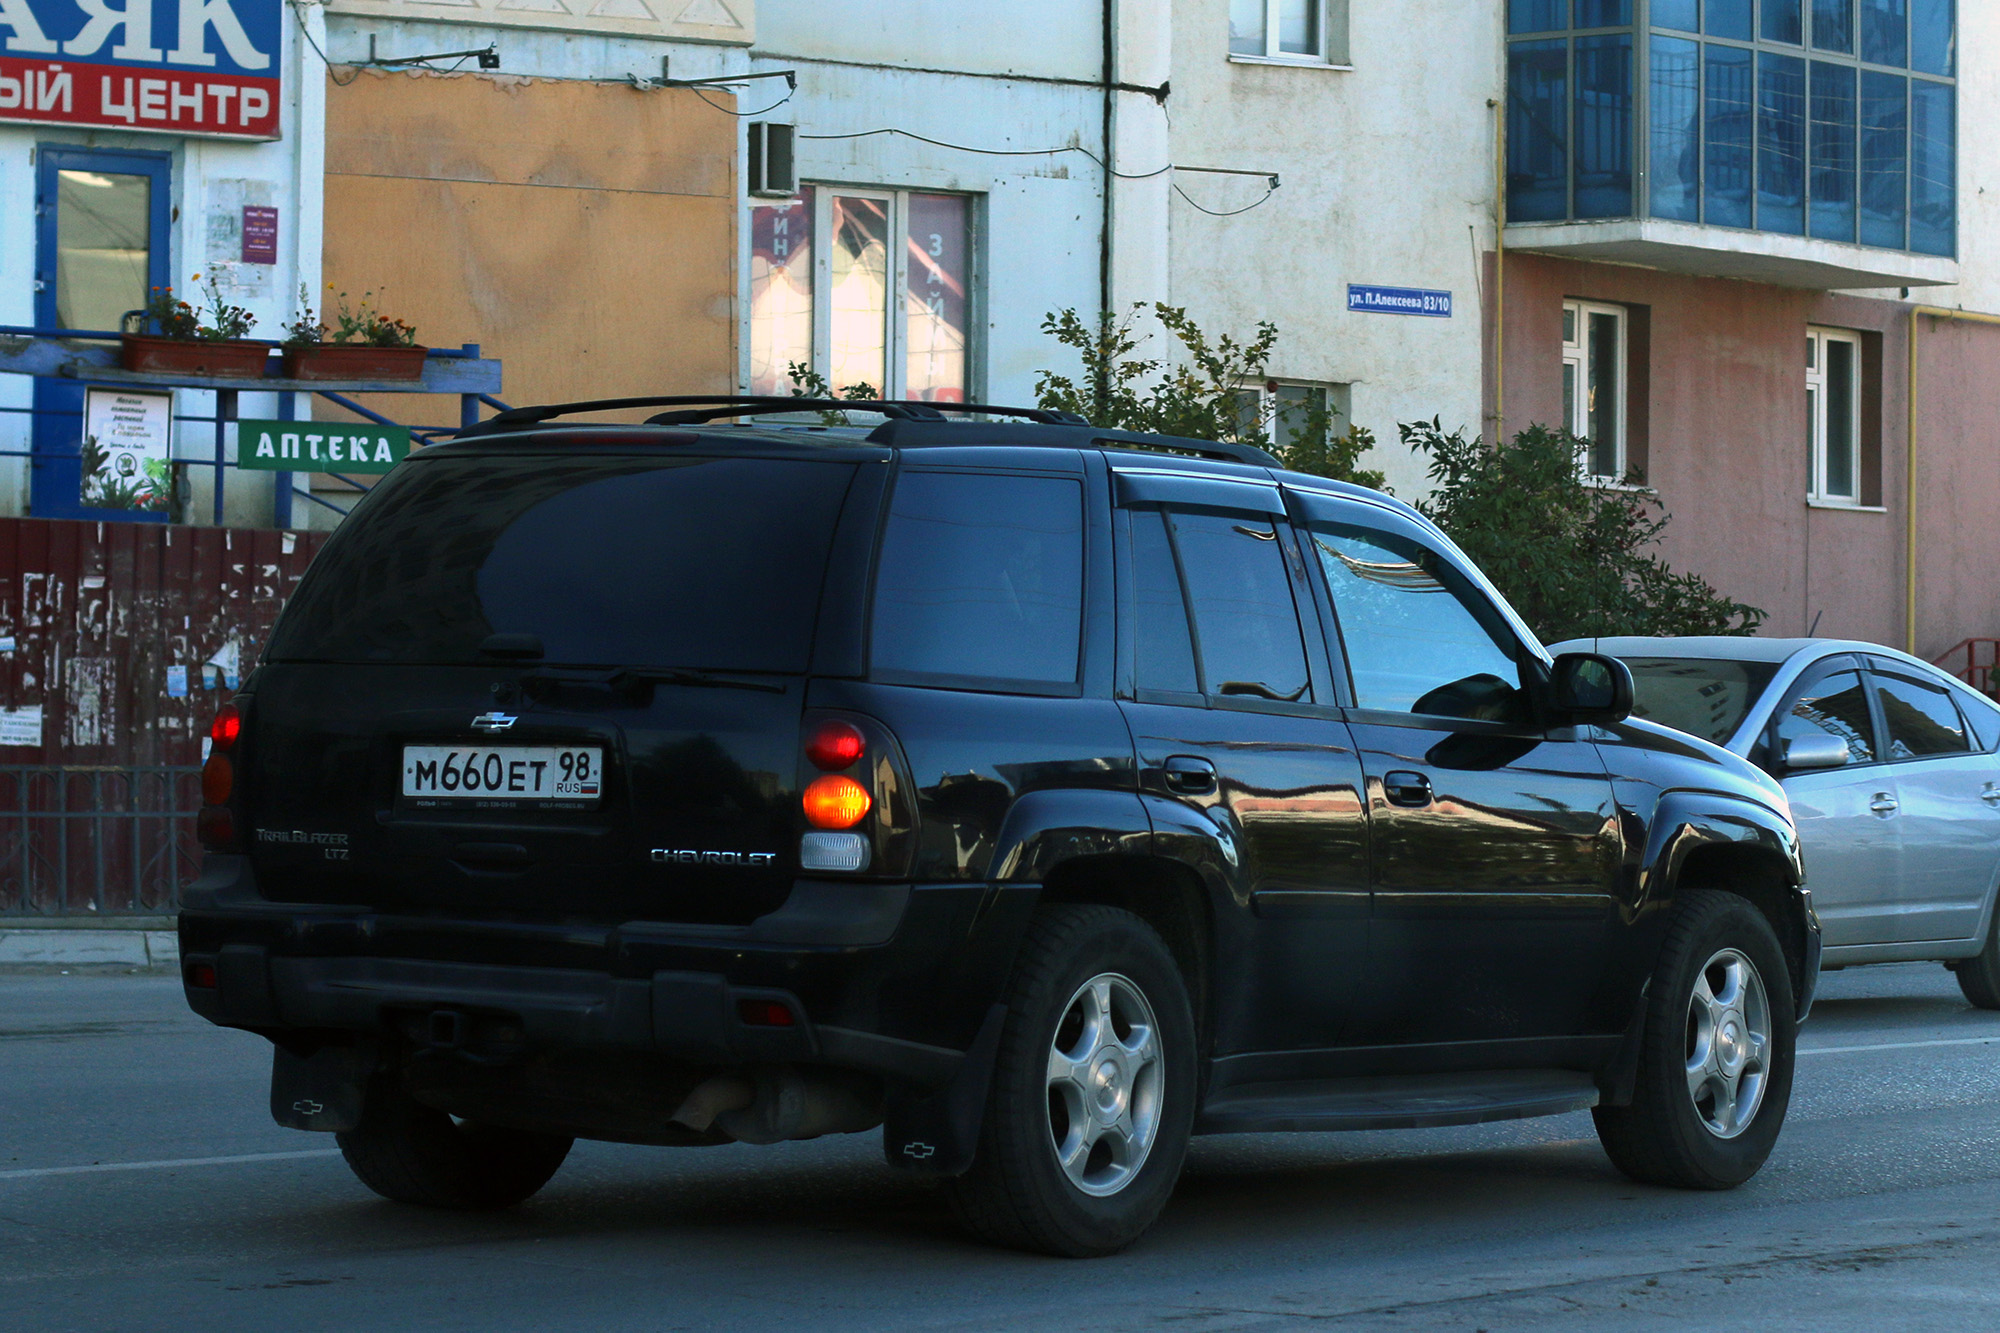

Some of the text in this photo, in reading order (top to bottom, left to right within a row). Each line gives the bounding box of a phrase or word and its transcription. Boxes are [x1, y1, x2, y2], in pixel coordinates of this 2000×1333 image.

[101, 75, 270, 126] ЦЕНТР
[1350, 292, 1450, 312] ул. П.Алексеева 83/10
[255, 432, 393, 463] АПТЕКА
[559, 751, 590, 782] 98
[556, 782, 580, 793] RUS
[325, 848, 349, 860] LTZ
[651, 848, 776, 866] CHEVROLET
